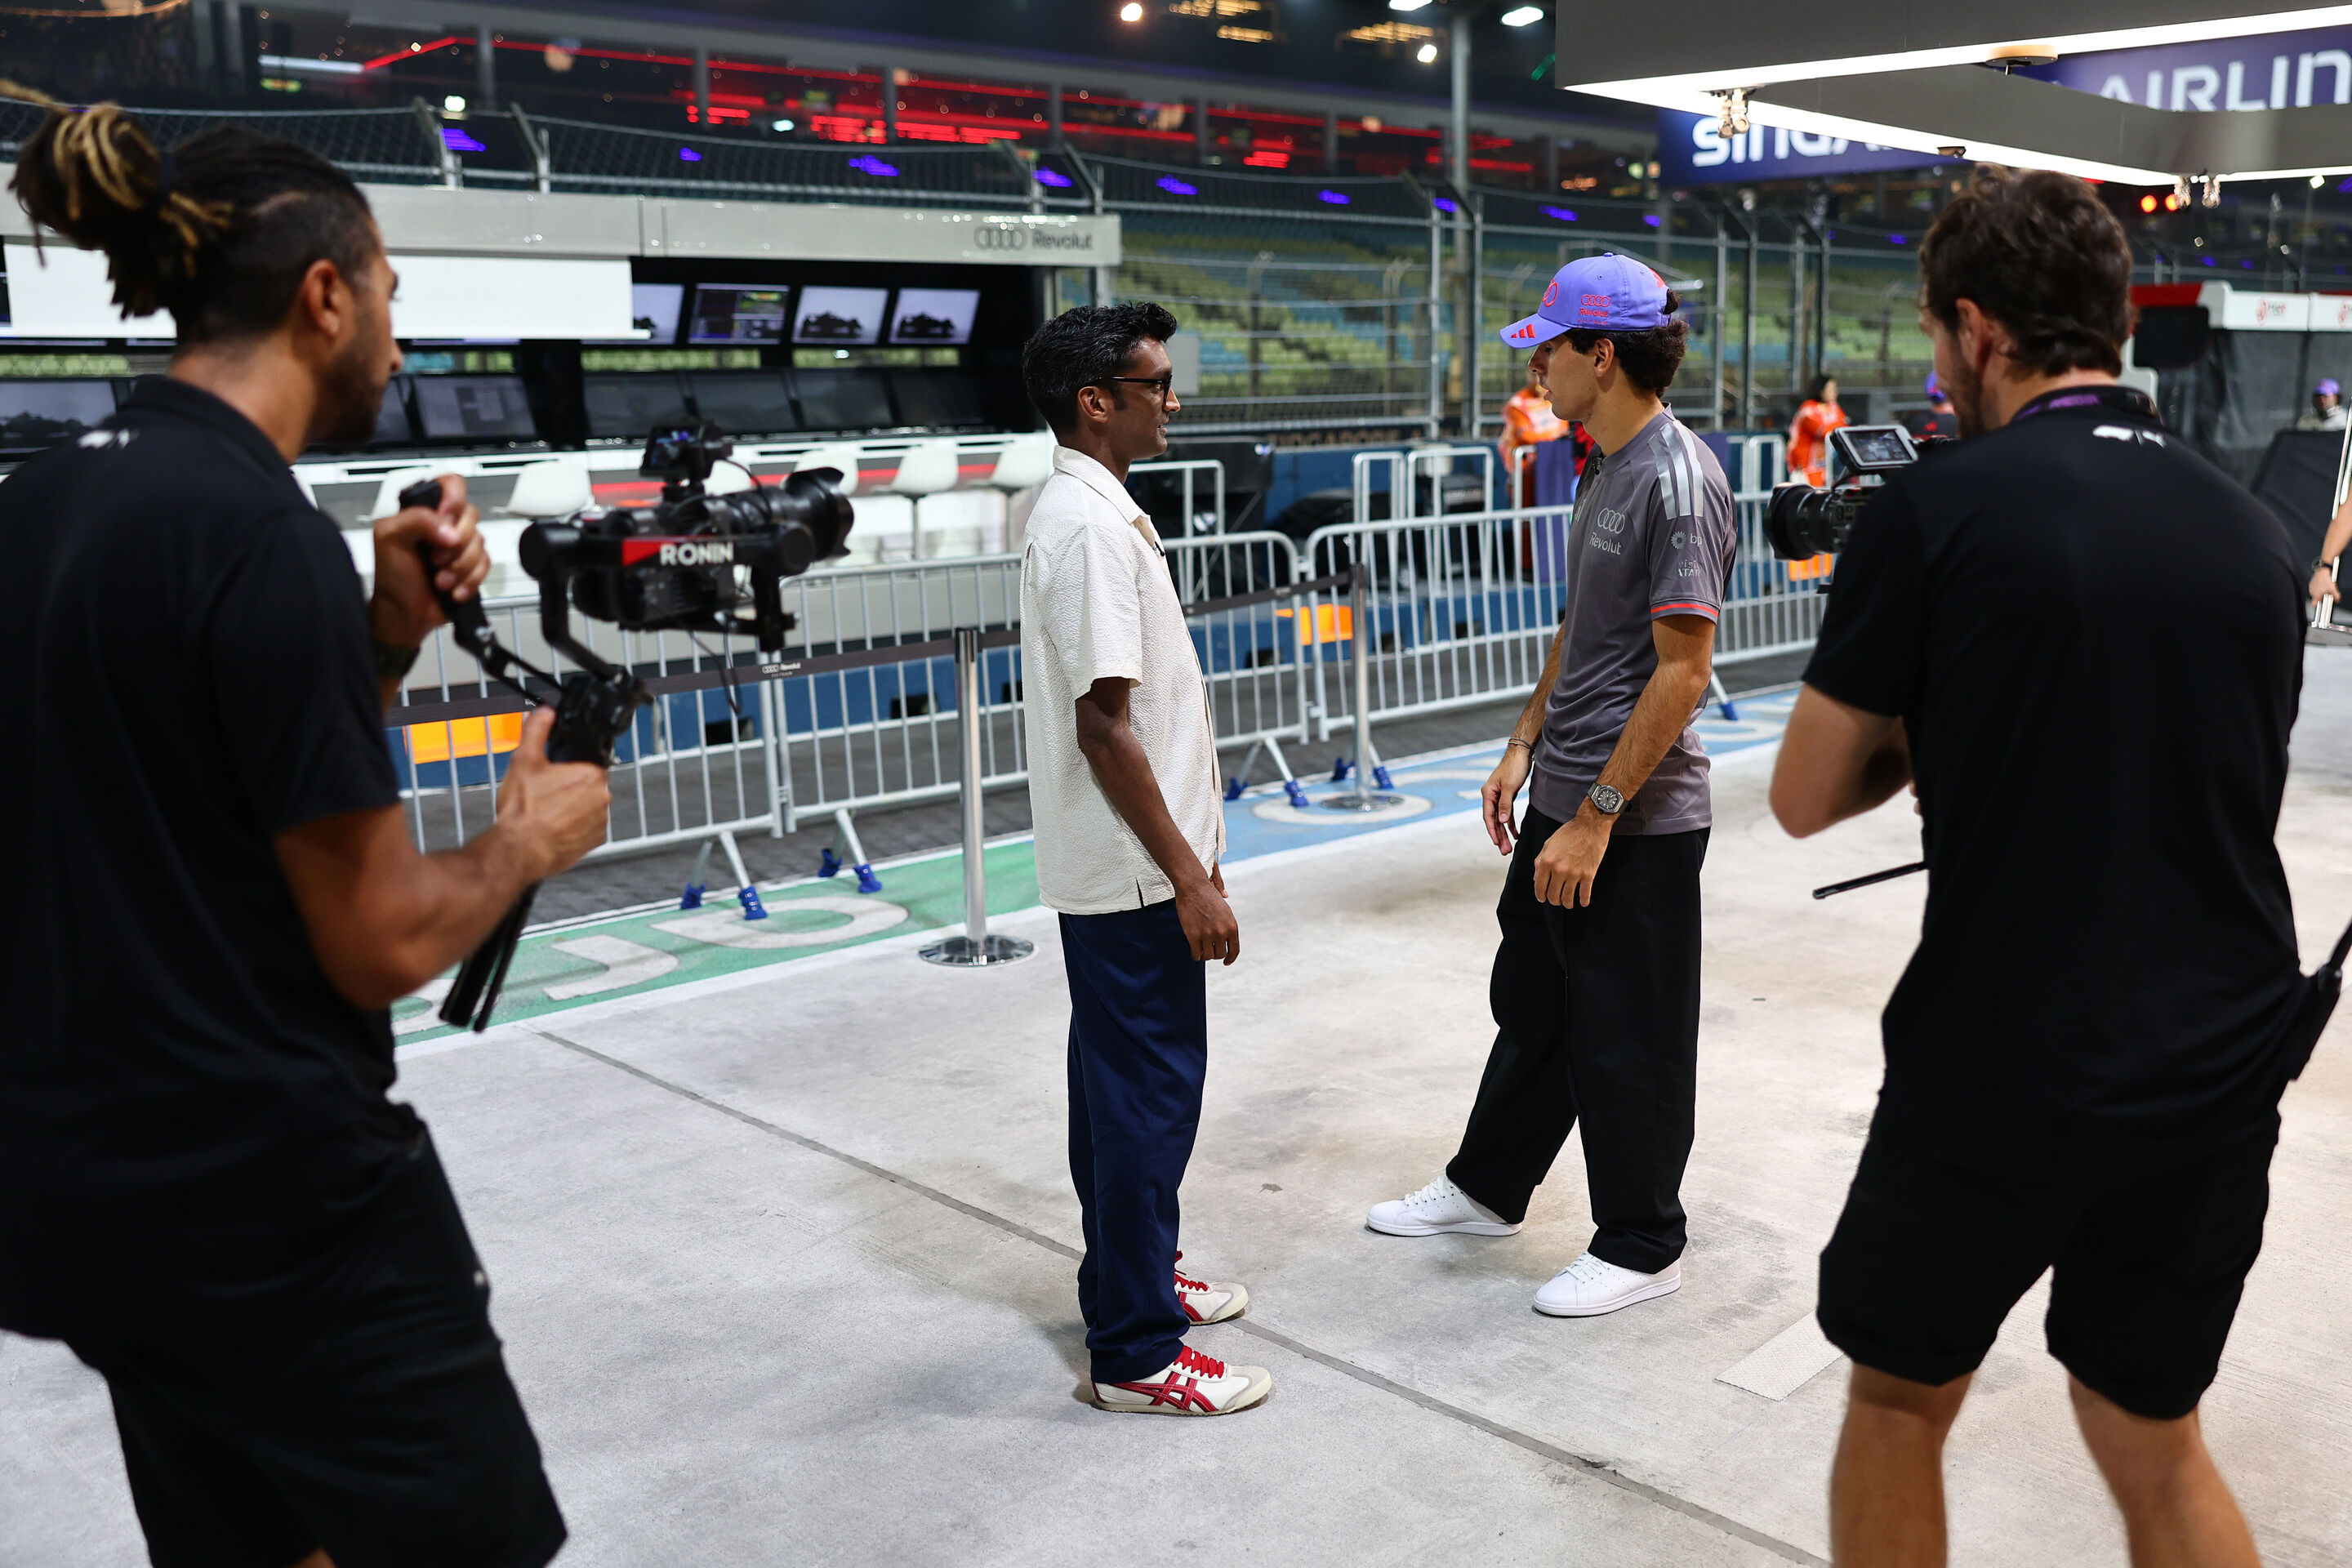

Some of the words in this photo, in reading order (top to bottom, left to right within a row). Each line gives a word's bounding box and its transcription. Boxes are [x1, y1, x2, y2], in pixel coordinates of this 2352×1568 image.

[1032, 229, 1093, 250] Revolut
[1579, 307, 1608, 317] Revolut
[1589, 532, 1622, 555] Revolut
[1690, 532, 1703, 547] bp
[660, 542, 733, 566] RONIN
